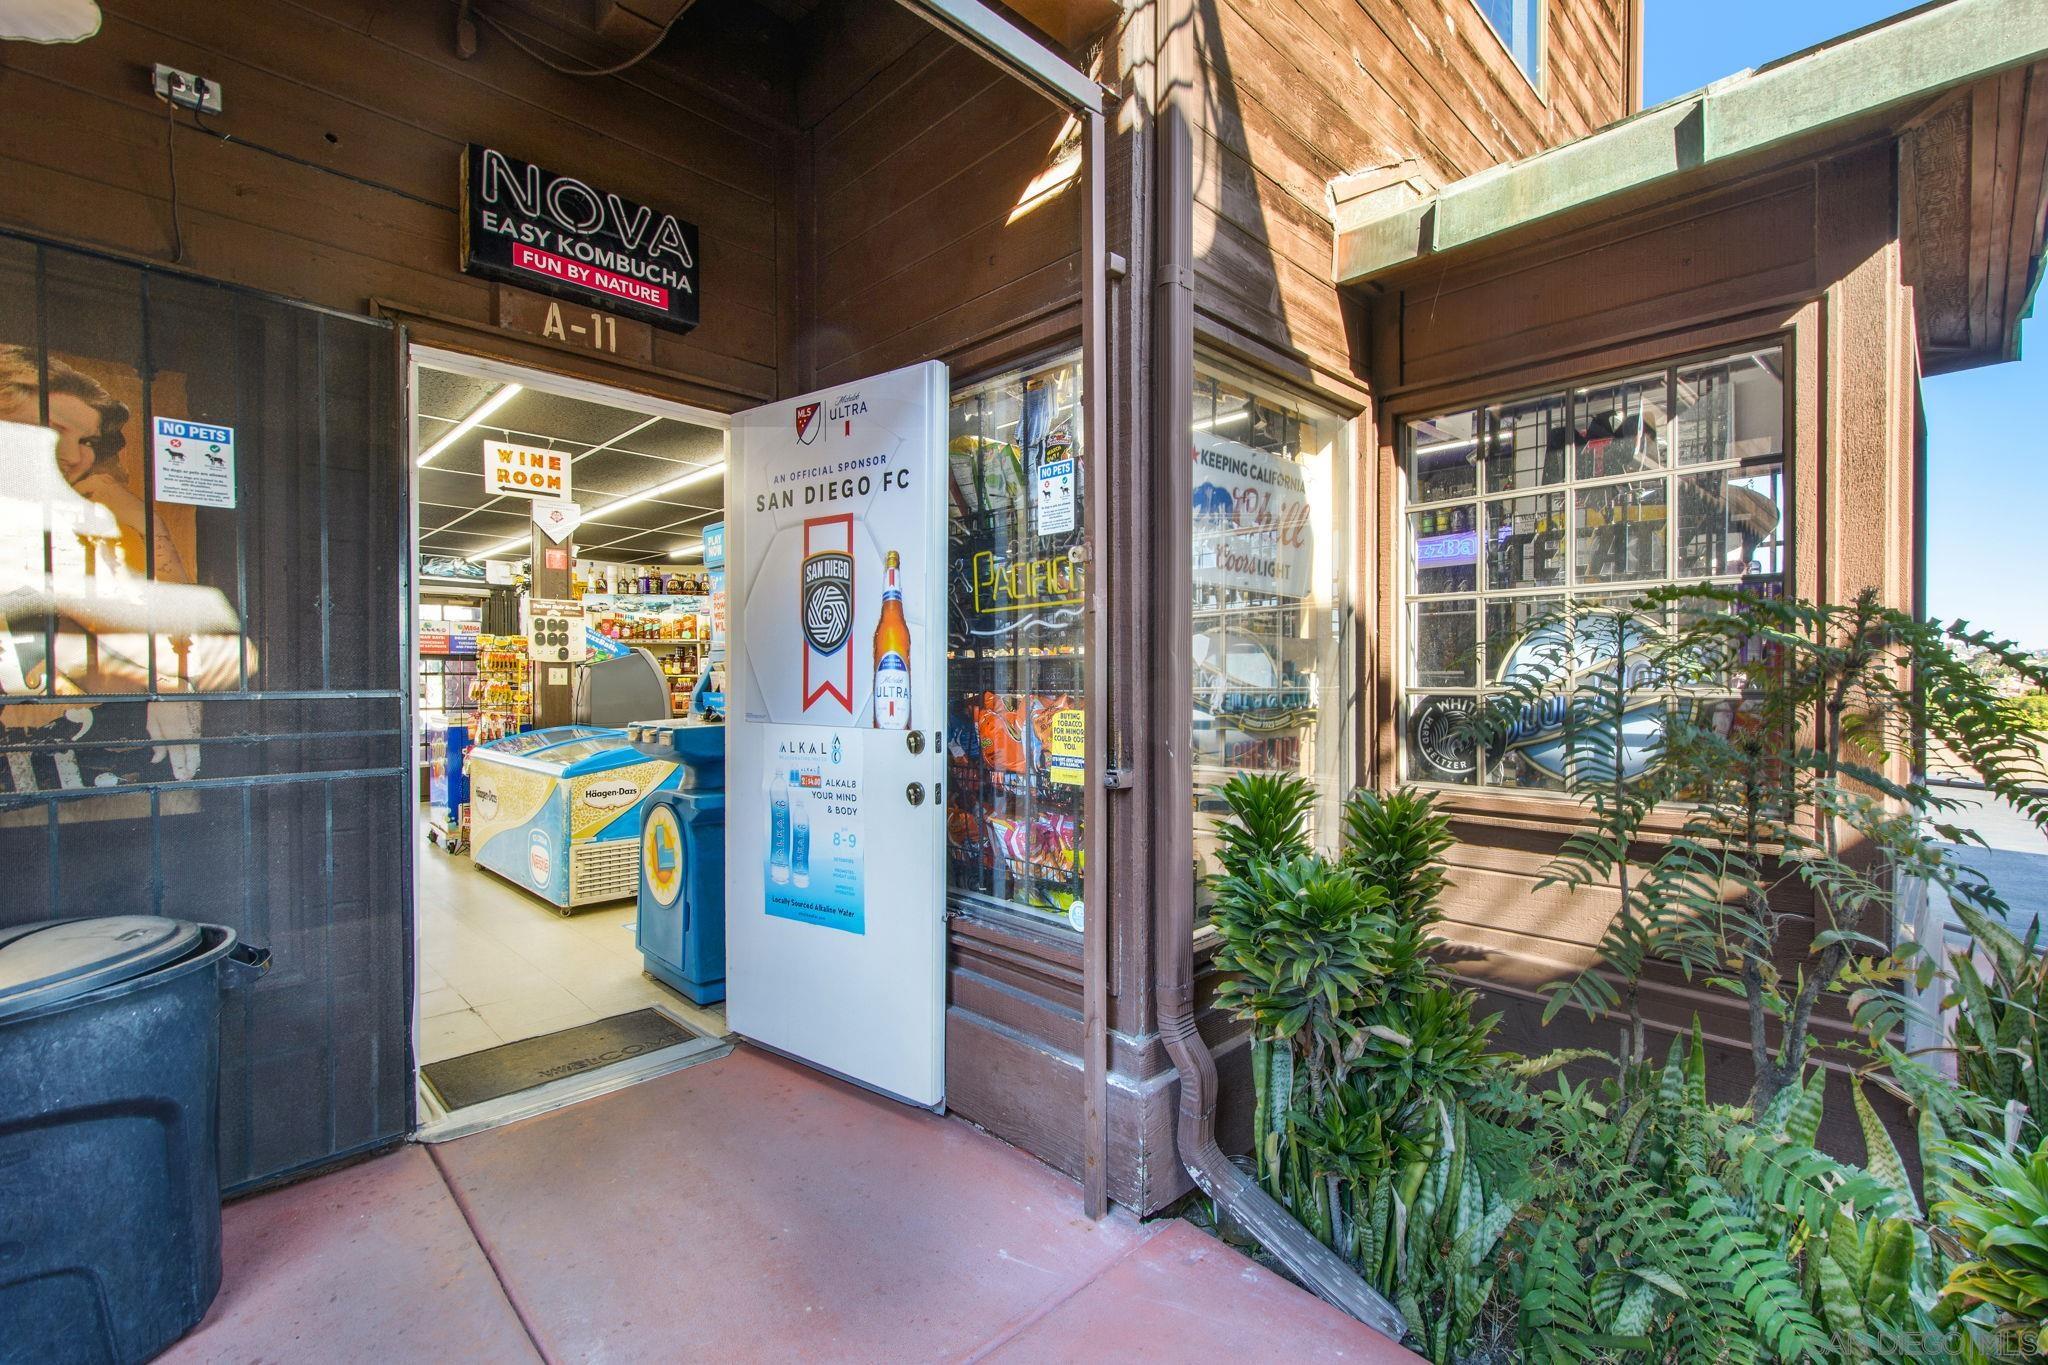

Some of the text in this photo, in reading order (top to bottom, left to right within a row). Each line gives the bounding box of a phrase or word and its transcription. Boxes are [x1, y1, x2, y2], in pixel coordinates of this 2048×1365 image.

[482, 149, 693, 269] NOVA
[482, 210, 692, 294] EASY KOMBUCHA
[523, 250, 661, 303] FUN BY NATURE
[542, 302, 617, 353] A-11
[797, 406, 812, 419] MLS
[829, 401, 868, 421] ULTRA
[163, 422, 227, 442] NO PETS
[497, 448, 561, 471] WINE
[774, 454, 887, 485] AN OFFICIAL SPONSOR
[1041, 462, 1071, 478] NO PETS
[496, 468, 561, 490] ROOM
[1201, 449, 1306, 494] KEEPING CALIFORNIA
[756, 468, 910, 513] SAN DIEGO FC
[1231, 487, 1311, 549] Chill
[707, 533, 722, 546] PLAY
[708, 545, 722, 557] NOW
[1216, 543, 1292, 580] Coors LIGHT
[806, 559, 849, 582] SAN DIEGO
[974, 550, 1084, 613] PACIFICO
[822, 608, 832, 621] FC
[876, 686, 909, 700] ULTRA
[1060, 712, 1081, 721] BUYING
[1436, 698, 1478, 717] WHIT
[1057, 720, 1083, 728] TOBACCO
[1422, 716, 1434, 744] HARD
[1053, 735, 1072, 743] COULD
[1426, 747, 1467, 769] SELTZER
[825, 779, 857, 789] ALKAL8
[811, 791, 857, 802] YOUR MIND
[827, 805, 858, 815] & BODY
[772, 896, 790, 906] Locally
[791, 899, 814, 910] Sourced
[538, 1033, 681, 1077] WELCOME
